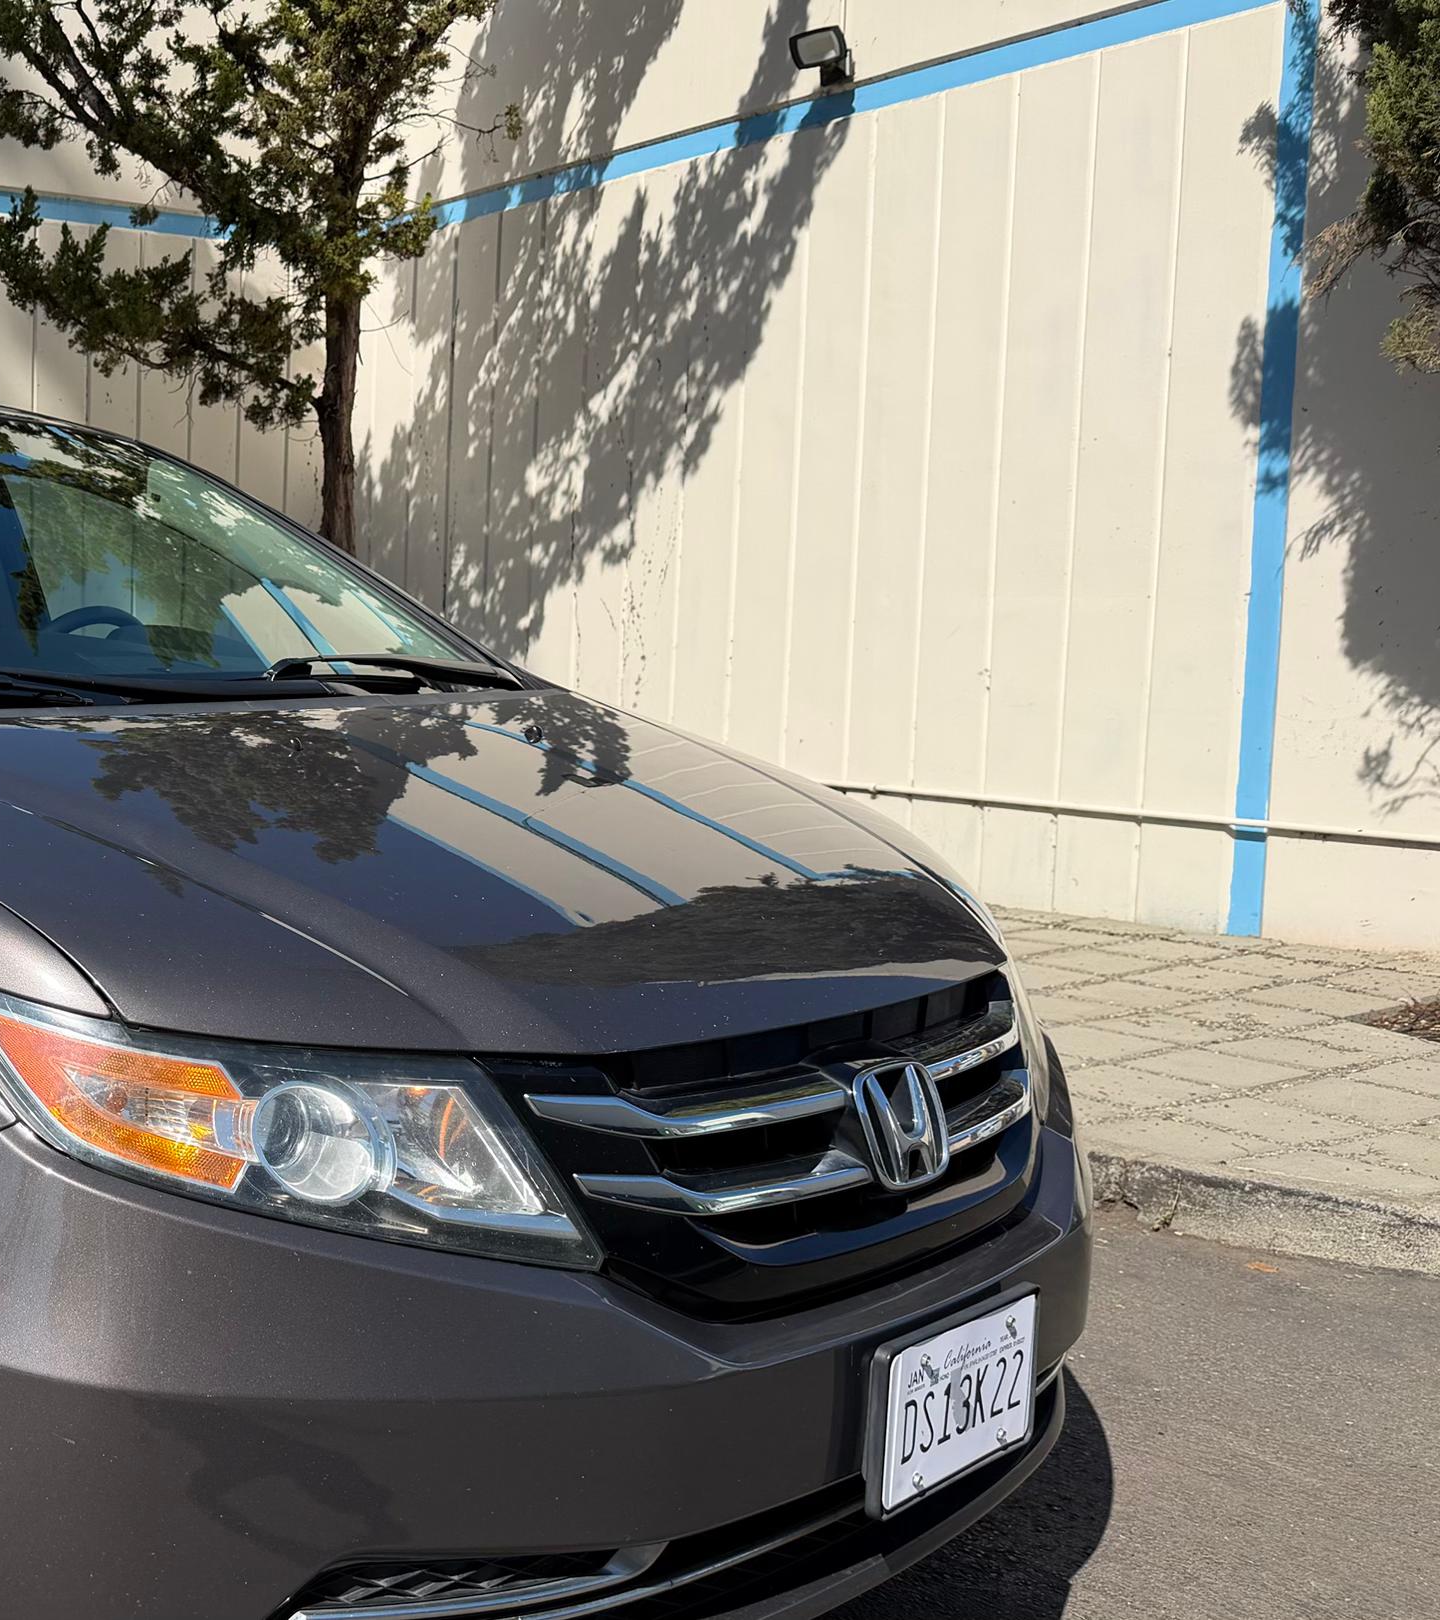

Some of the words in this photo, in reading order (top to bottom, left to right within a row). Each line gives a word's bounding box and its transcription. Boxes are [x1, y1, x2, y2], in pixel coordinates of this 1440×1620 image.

[943, 1337, 992, 1372] California
[907, 1368, 925, 1389] JAN
[901, 1349, 1024, 1466] DS13K22
